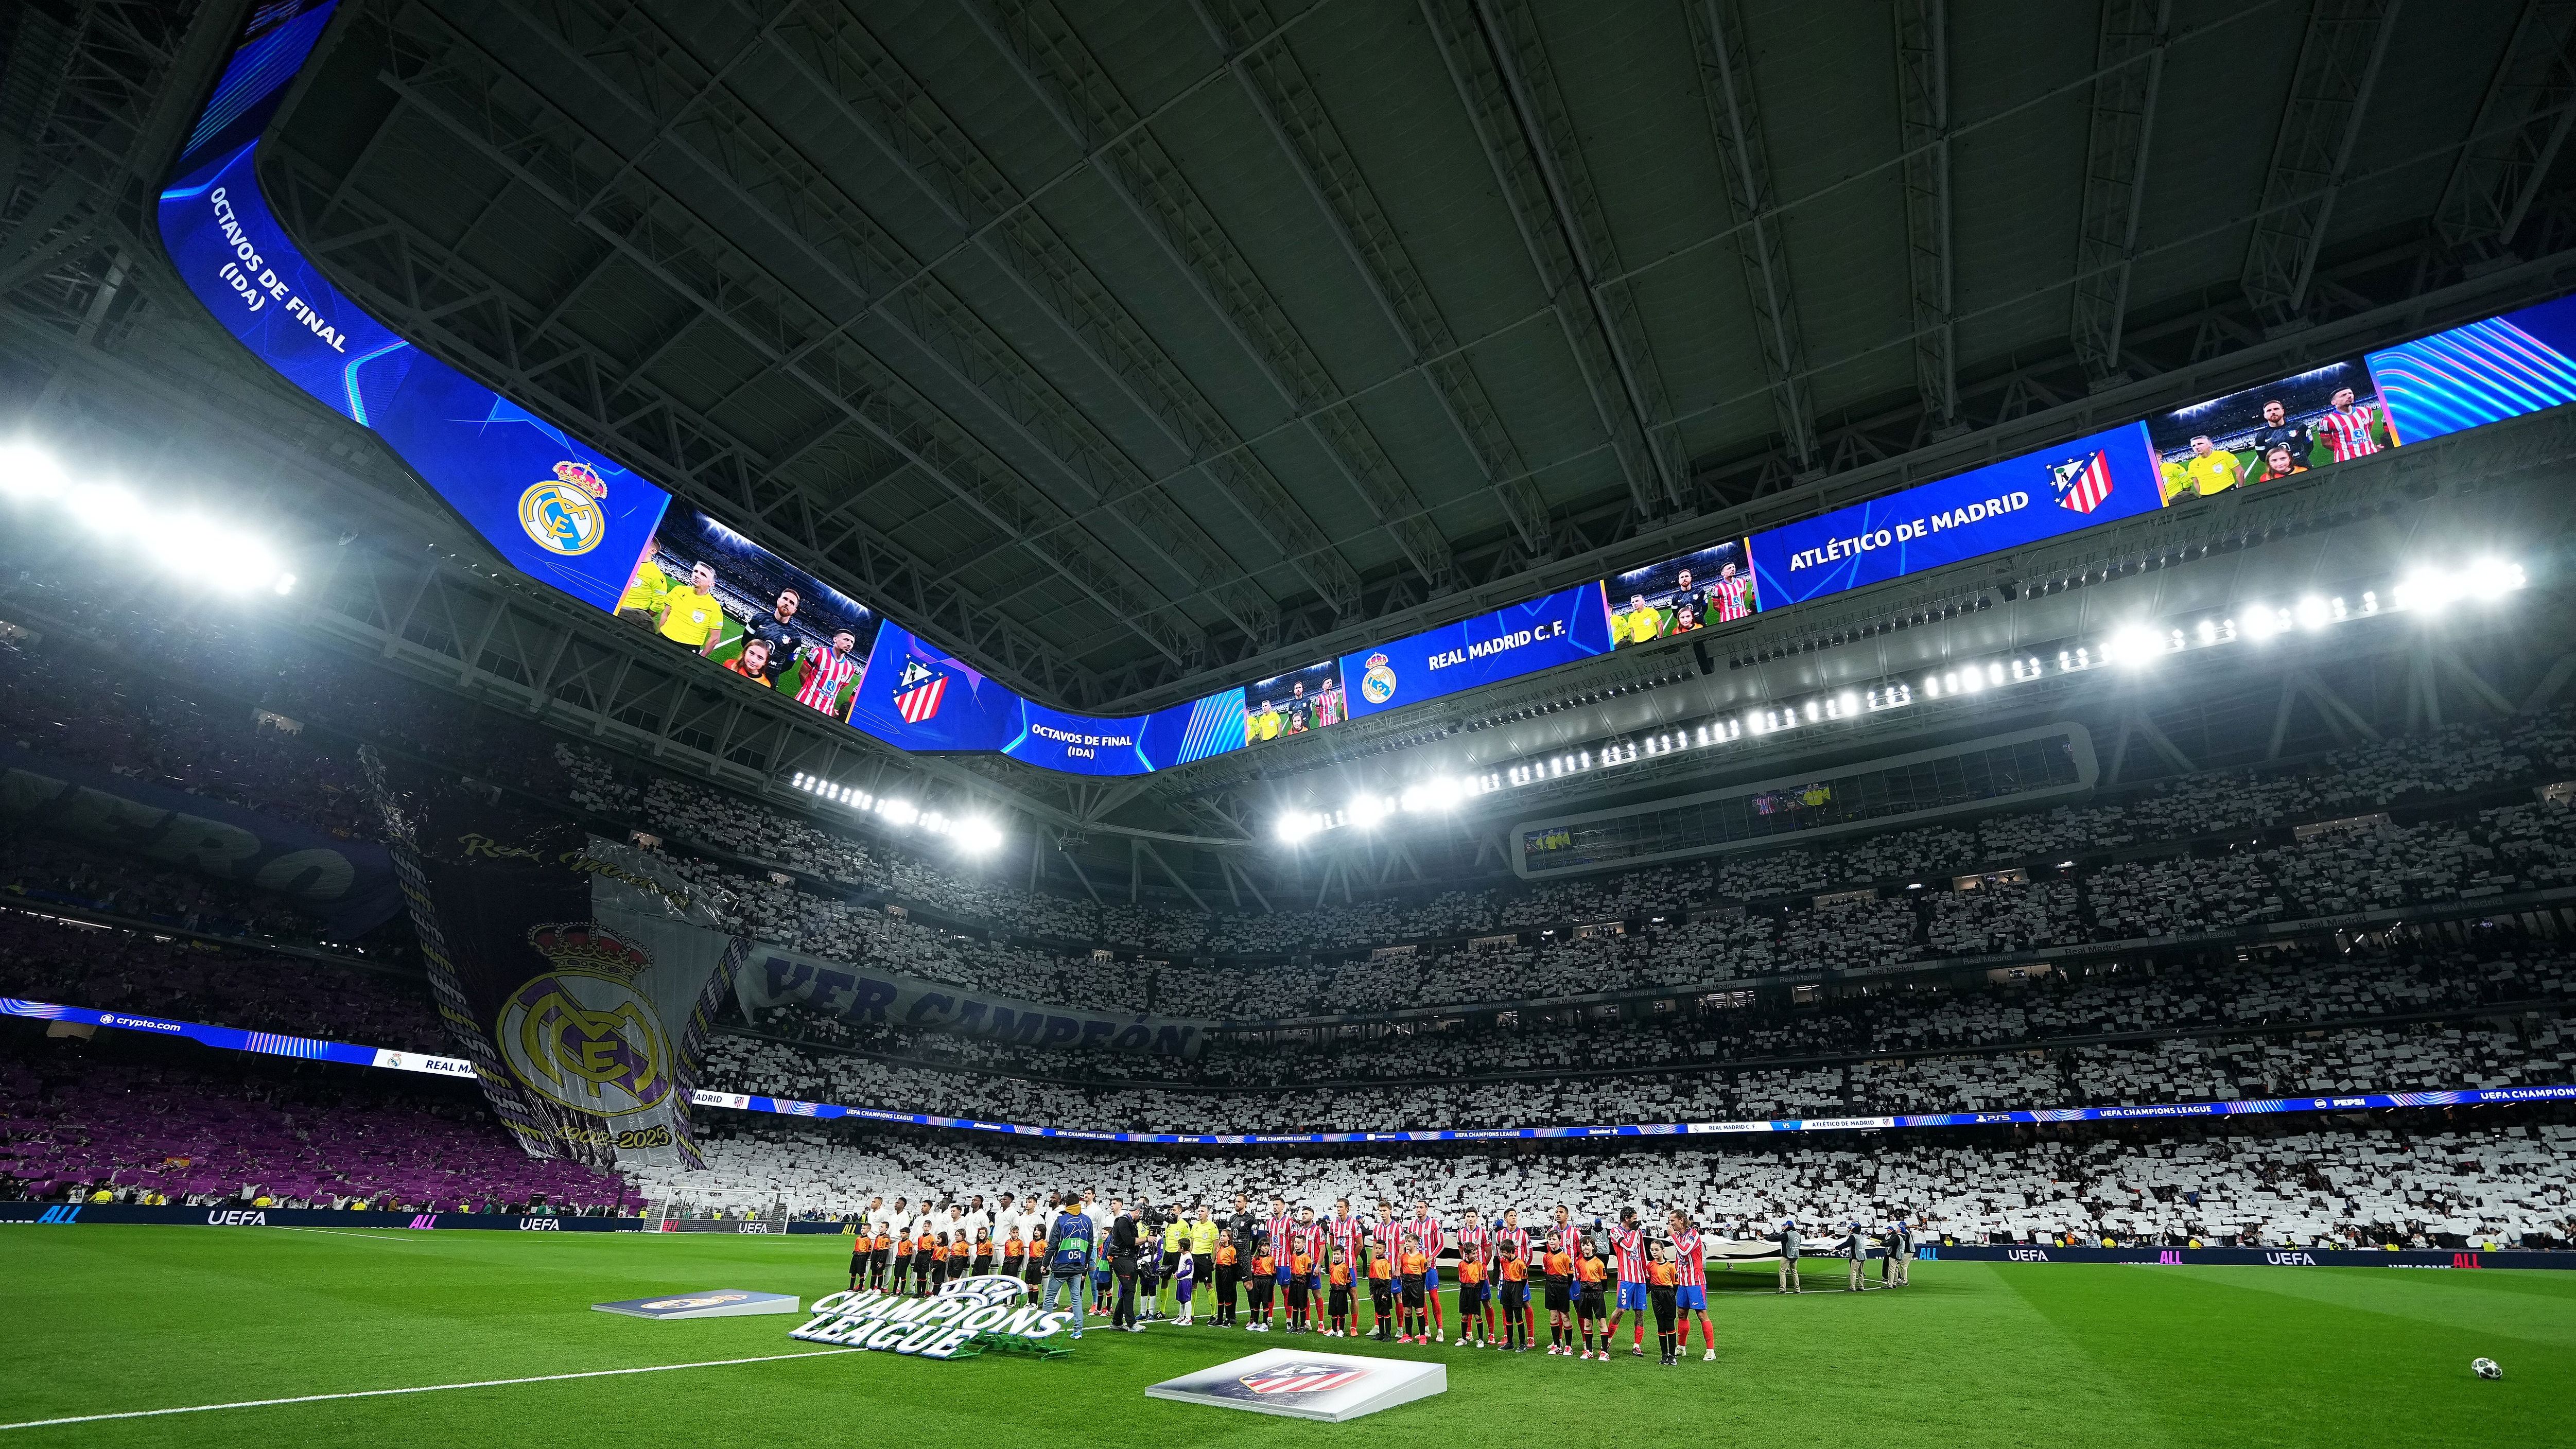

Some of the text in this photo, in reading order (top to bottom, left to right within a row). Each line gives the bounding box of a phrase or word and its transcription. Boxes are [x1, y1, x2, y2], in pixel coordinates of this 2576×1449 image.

[211, 187, 345, 353] OCTAVOS DE FINAL
[219, 263, 265, 311] (IDA)
[1790, 491, 2029, 571] ATLÉTICO DE MADRID
[1429, 620, 1565, 670] REAL MADRID C. F.
[1032, 724, 1133, 746] OCTAVOS DE FINAL
[1068, 746, 1094, 759] (IDA)
[2300, 915, 2365, 930] Real Madrid
[2088, 944, 2120, 953] Madrid
[1983, 954, 2012, 963] Madrid
[1887, 965, 1914, 973] Madrid
[764, 955, 1194, 1057] VER CAMPEÓN
[116, 1017, 181, 1032] crypto.com
[426, 1060, 454, 1071] REAL
[2480, 1088, 2576, 1099] UEFA CHAMPION
[2123, 1108, 2175, 1116] CHAMPIONS
[37, 1206, 82, 1224] ALL
[207, 1210, 266, 1226] UEFA
[408, 1215, 437, 1229] ALL
[520, 1218, 560, 1231] UEFA
[739, 1223, 768, 1233] UEFA
[841, 1224, 856, 1235] ALL
[1919, 1248, 1938, 1260] ALL
[2008, 1249, 2049, 1262] UEFA
[2160, 1251, 2182, 1264] ALL
[2267, 1252, 2316, 1265] UEFA
[2453, 1253, 2481, 1268] ALL
[1622, 1288, 1627, 1298] 5
[810, 1290, 1074, 1339] CHAMPIONS
[788, 1313, 981, 1359] LEAGUE
